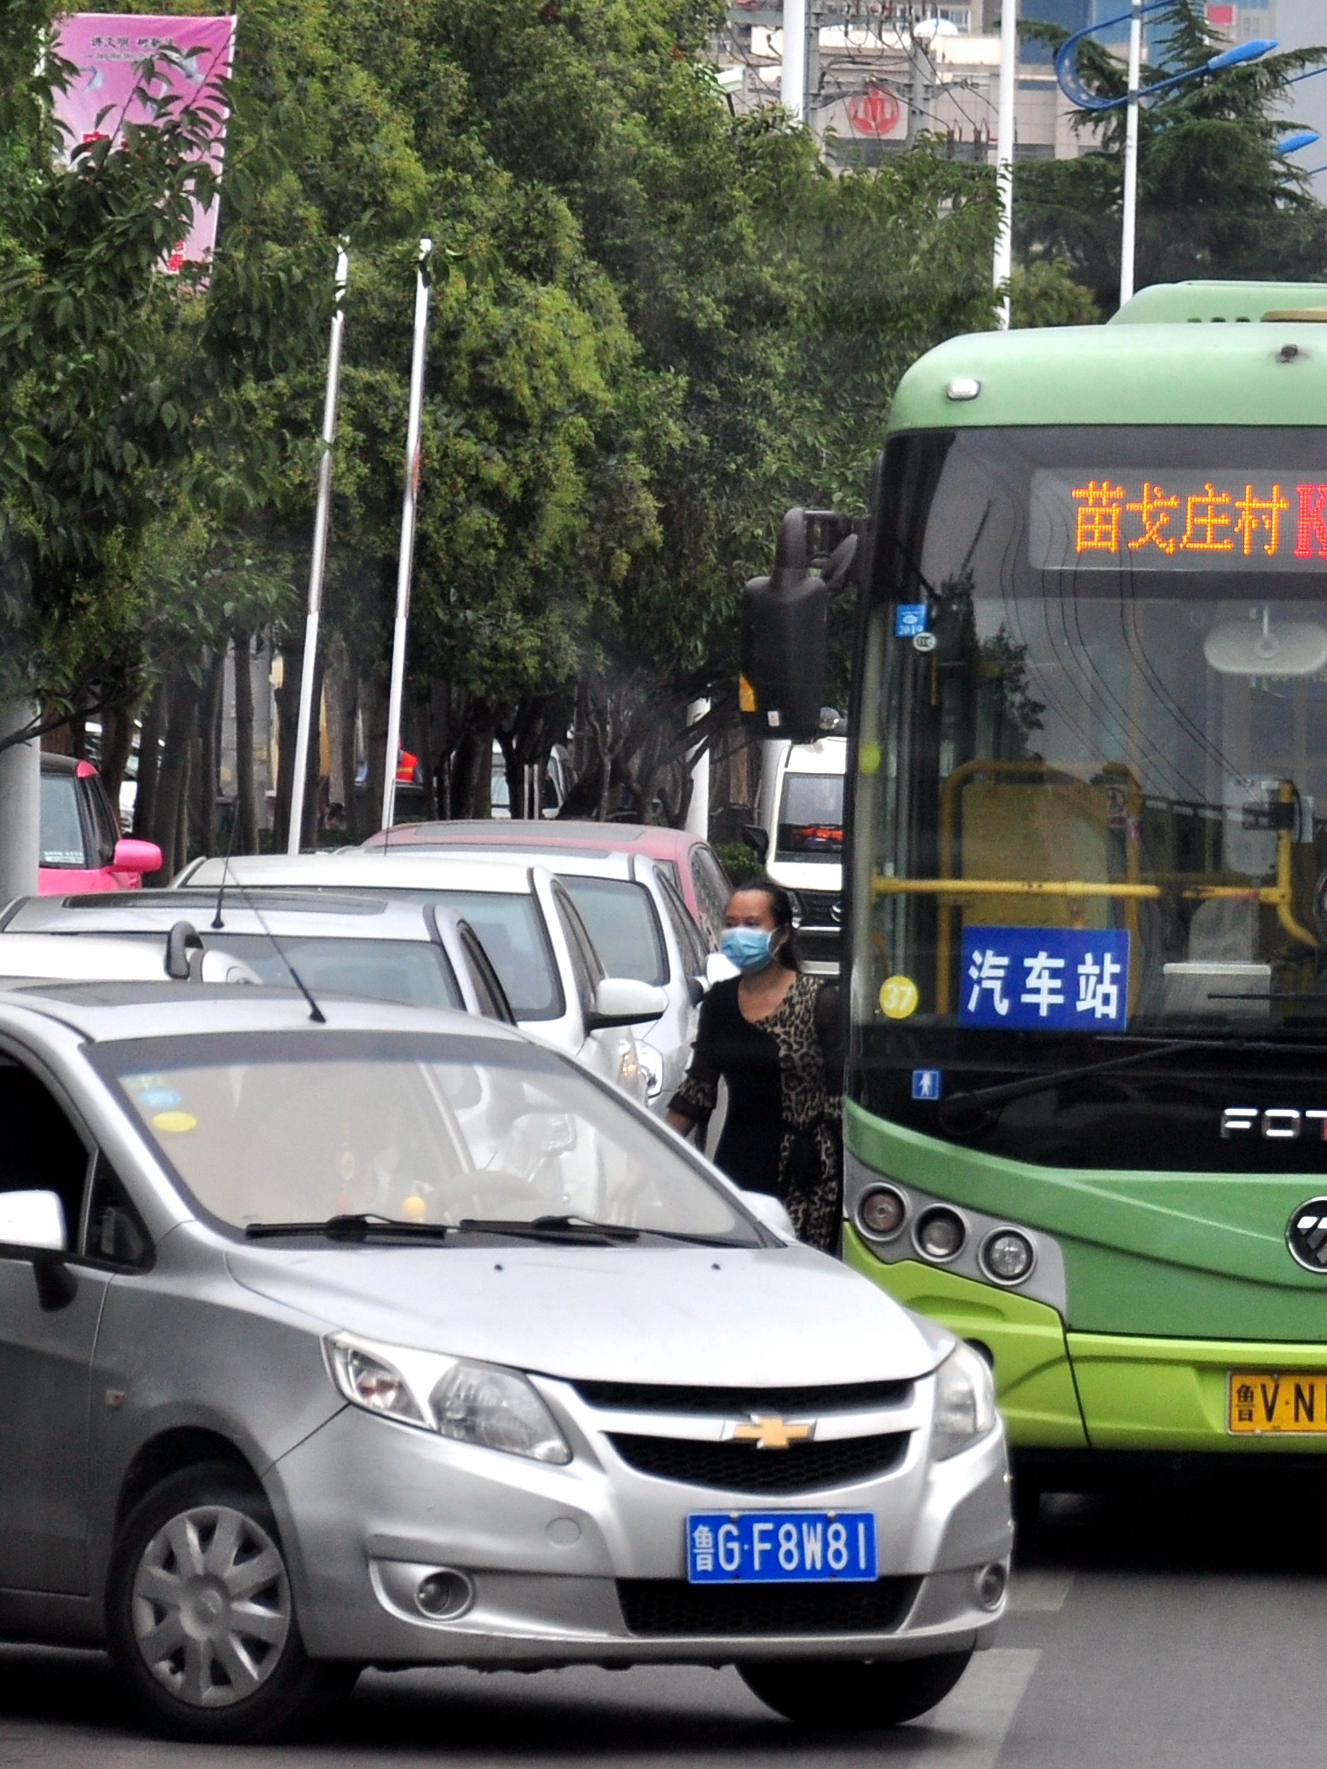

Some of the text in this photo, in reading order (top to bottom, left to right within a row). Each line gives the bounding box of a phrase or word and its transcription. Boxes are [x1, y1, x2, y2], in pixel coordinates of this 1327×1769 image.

[883, 983, 913, 1010] 37
[966, 950, 1121, 1018] 汽车站
